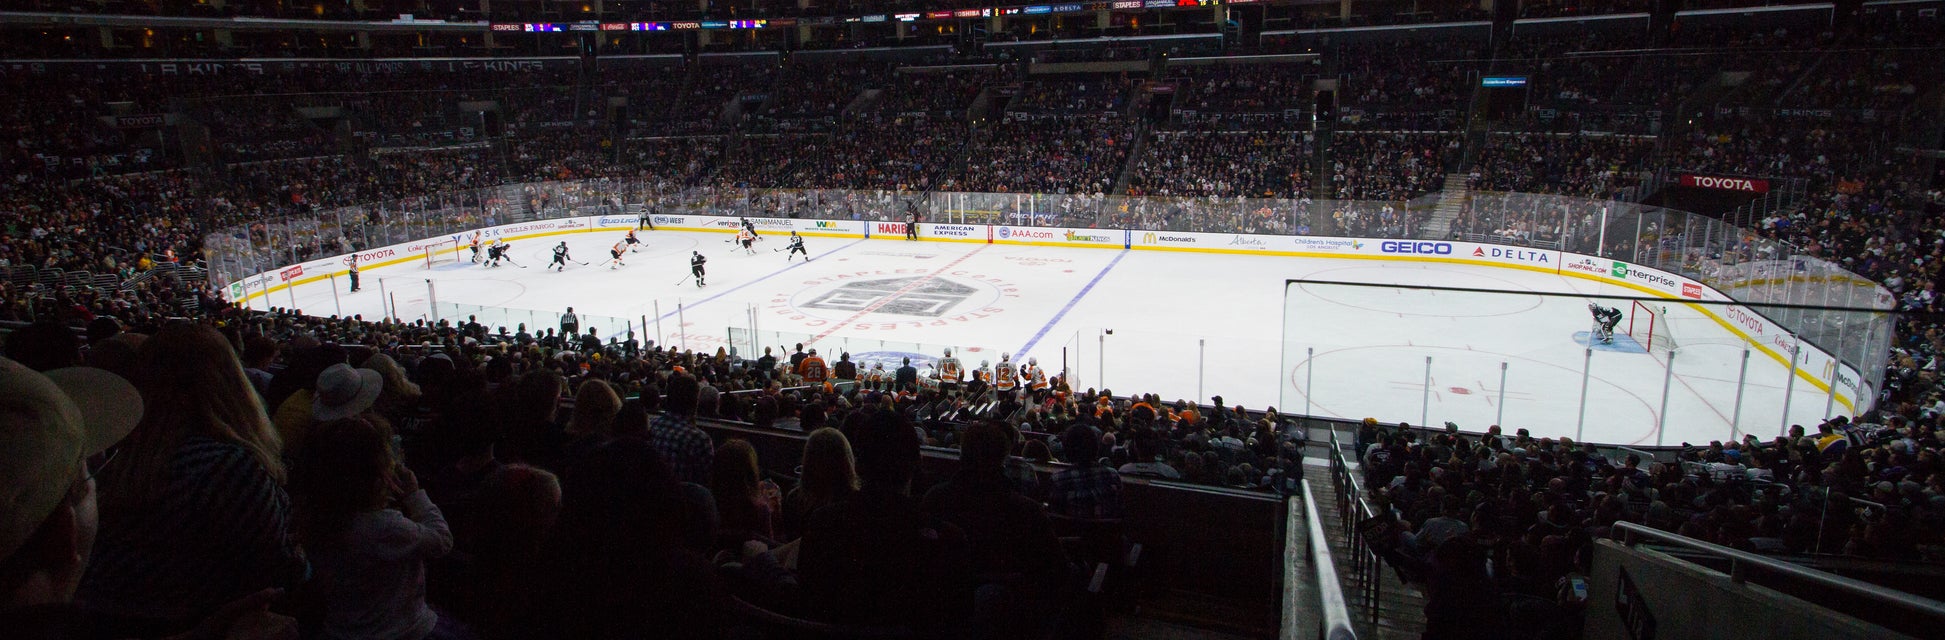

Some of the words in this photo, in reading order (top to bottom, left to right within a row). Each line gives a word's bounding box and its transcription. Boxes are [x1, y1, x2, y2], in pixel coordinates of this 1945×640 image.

[954, 9, 980, 18] TOSHIBA
[672, 22, 700, 30] TOYOTA
[121, 116, 163, 126] TOYOTA
[1693, 176, 1754, 191] TOYOTA
[669, 217, 685, 225] WEST
[717, 219, 740, 229] verizon
[767, 219, 794, 227] MANUEL
[503, 226, 529, 235] WELLS
[530, 222, 555, 232] FARGO
[878, 223, 912, 235] HARIB
[1011, 229, 1054, 239] AAA.com
[1158, 235, 1197, 243] McDonald's
[1325, 239, 1353, 249] Hospital
[1381, 241, 1452, 255] GEICO
[359, 248, 396, 262] TOYOTA
[1491, 247, 1549, 263] DELTA
[1615, 264, 1675, 288] enterprise
[1735, 308, 1763, 335] TOYOTA
